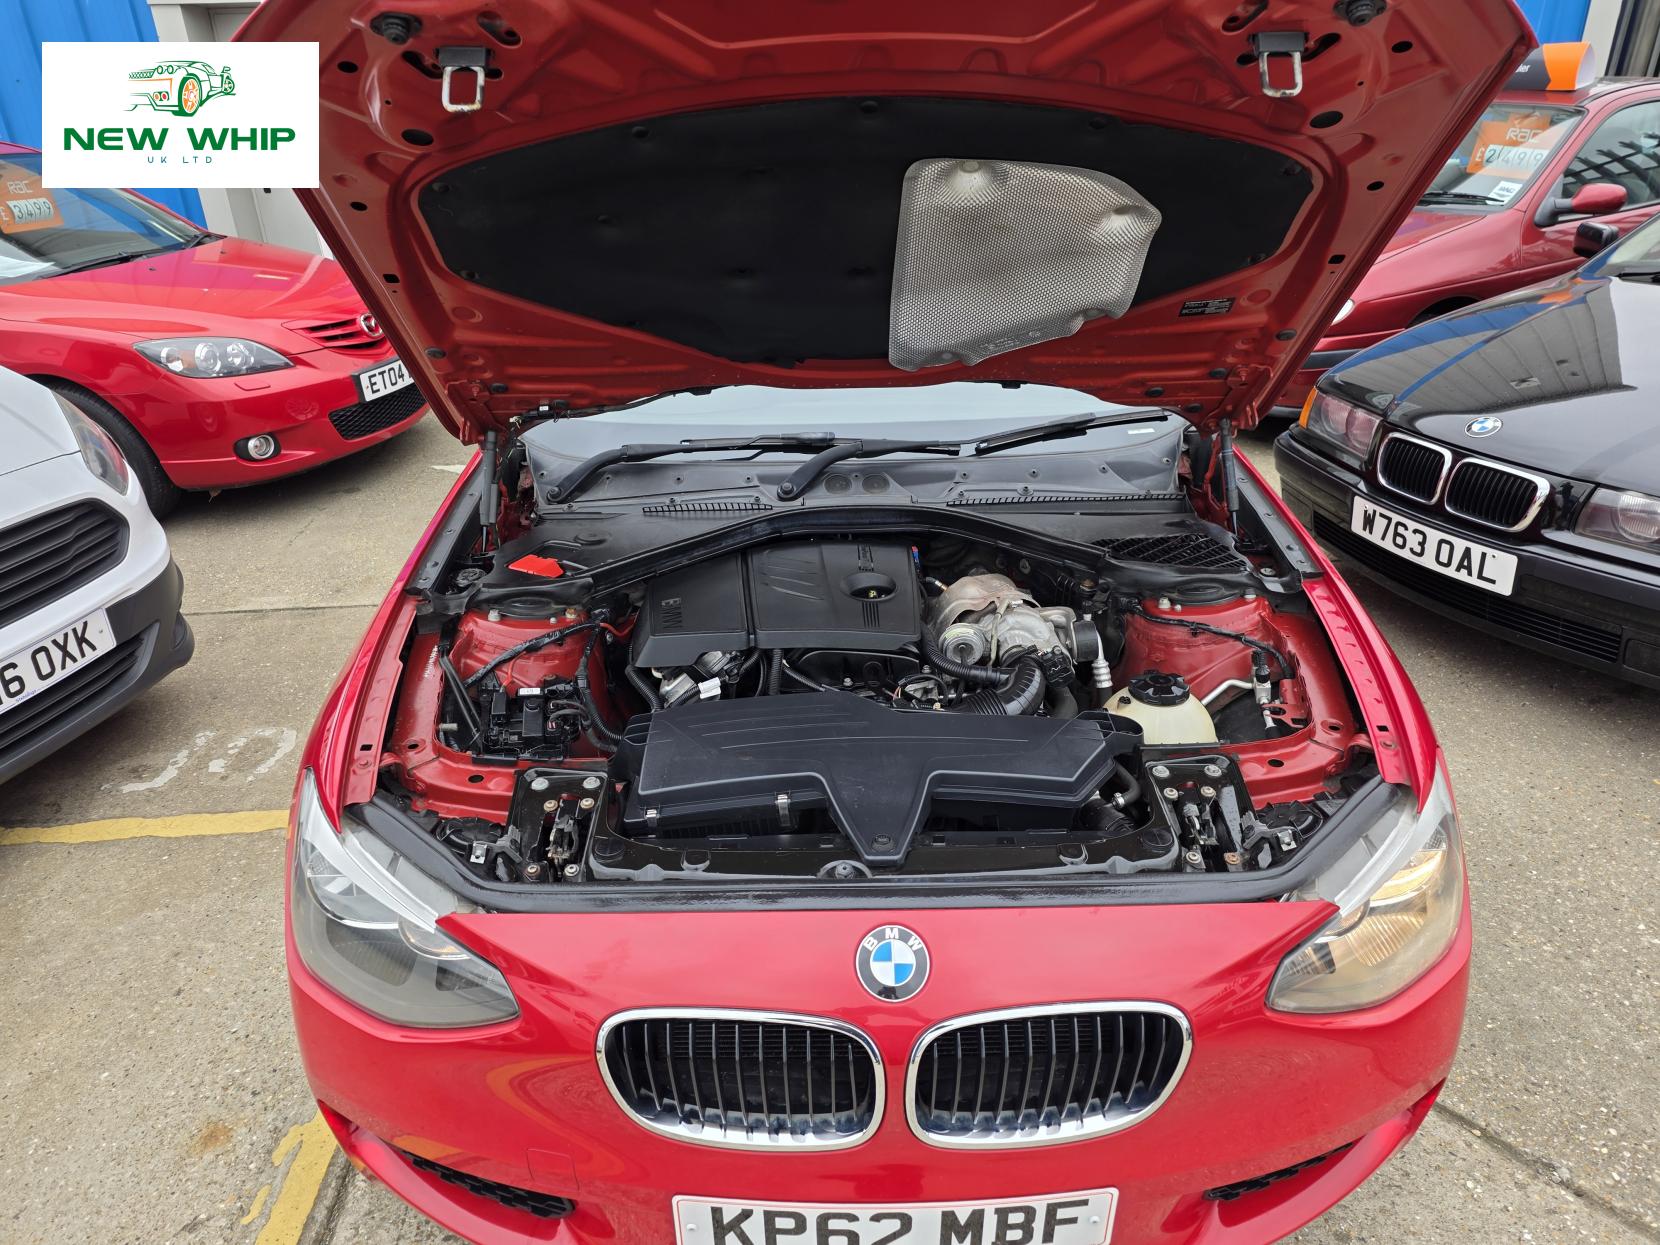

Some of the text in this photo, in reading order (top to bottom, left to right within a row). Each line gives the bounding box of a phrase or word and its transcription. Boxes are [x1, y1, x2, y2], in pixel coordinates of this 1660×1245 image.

[13, 200, 52, 220] 3499
[1362, 508, 1497, 585] W763 OAL
[0, 620, 97, 706] 6 OXK
[863, 927, 923, 951] BMW
